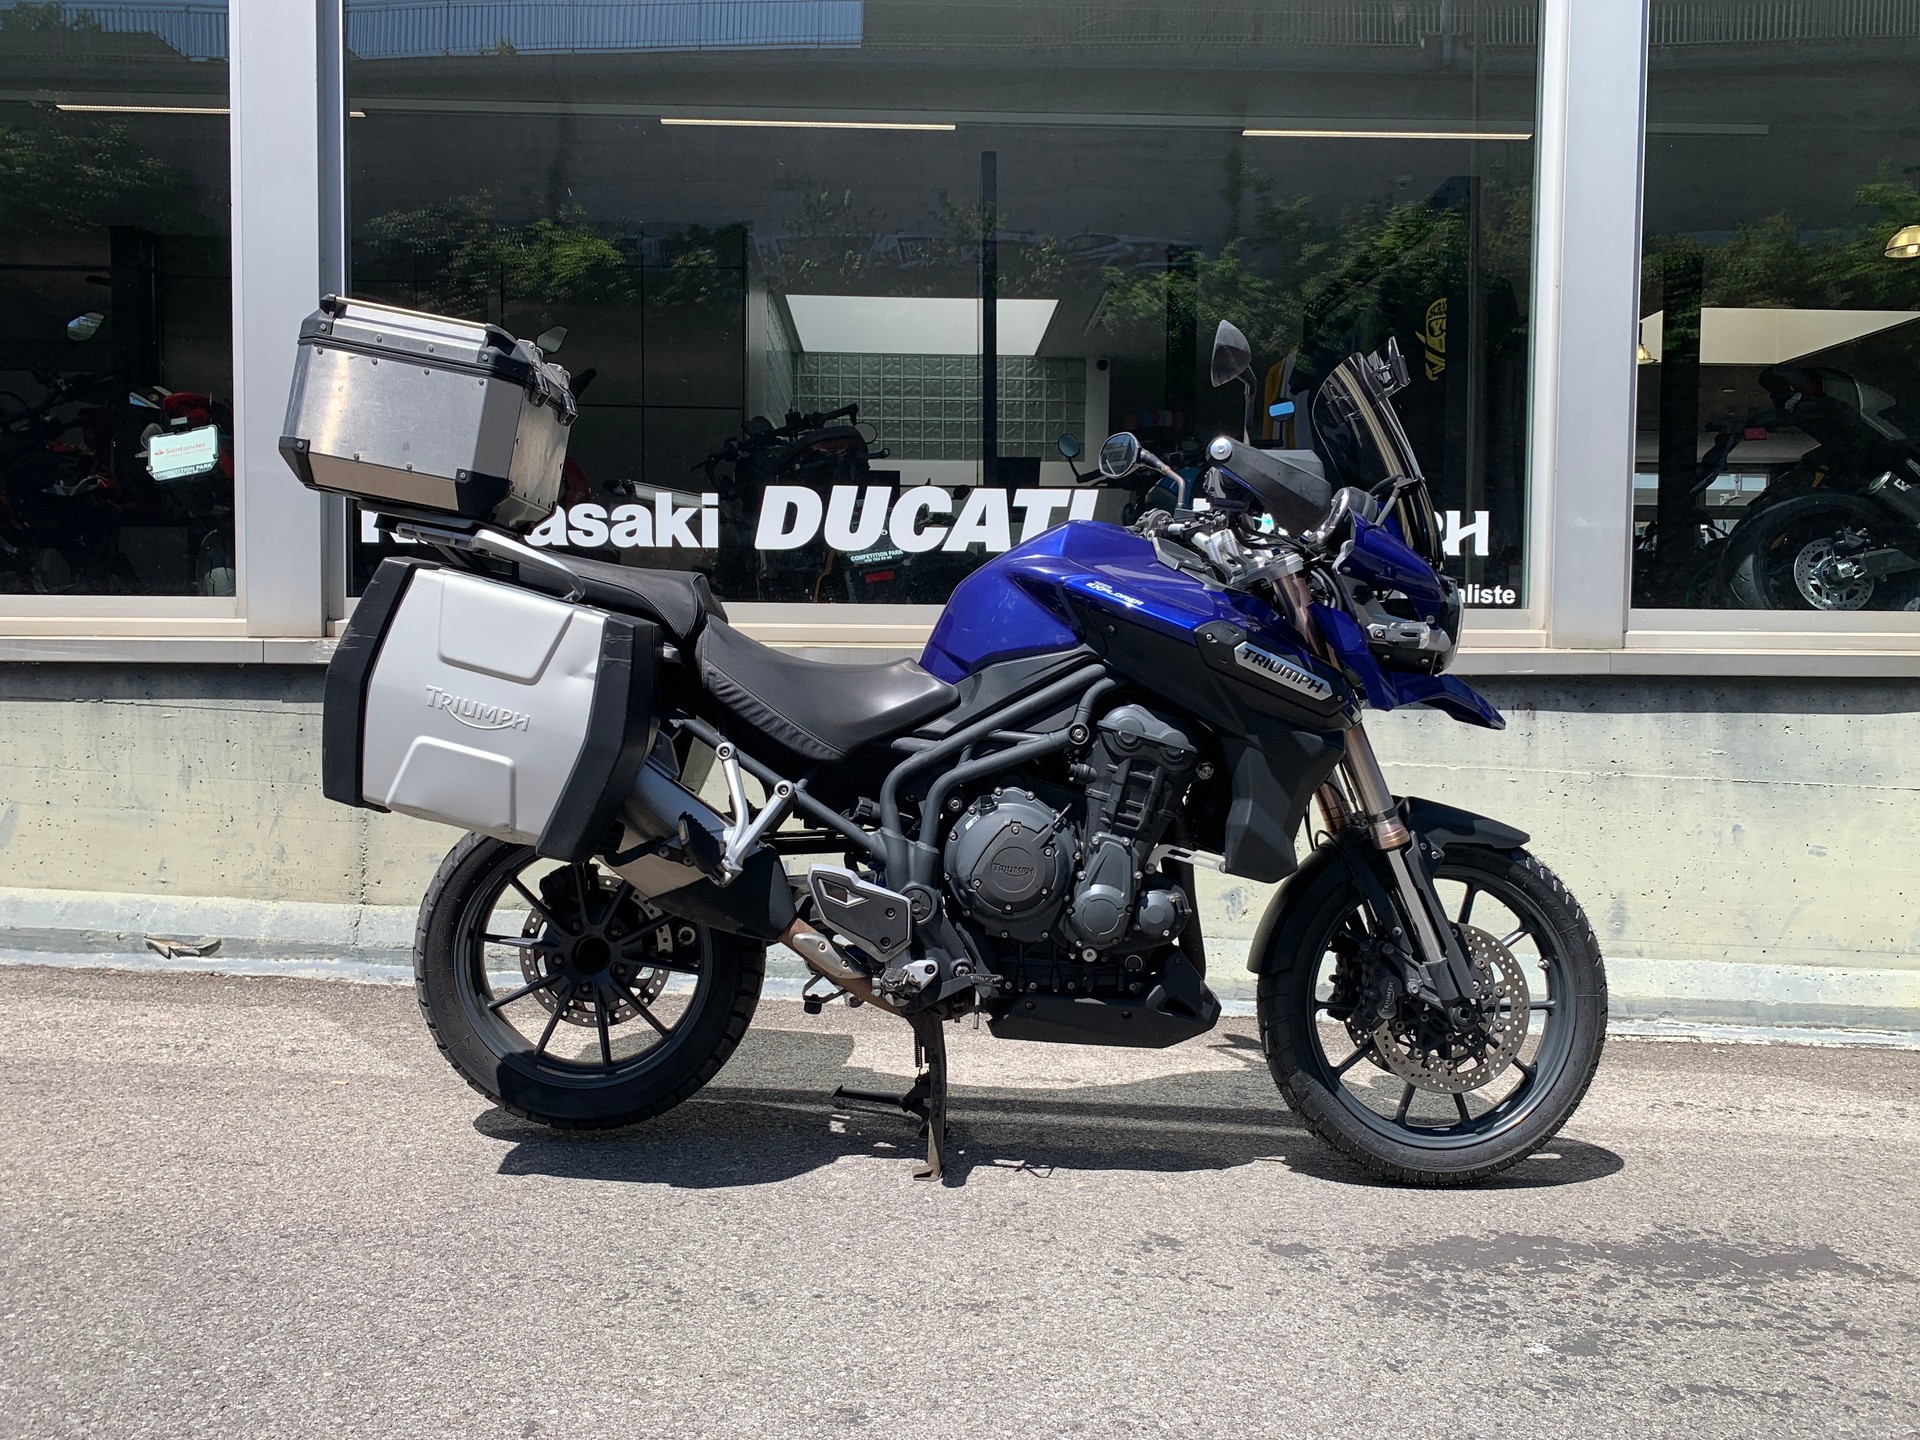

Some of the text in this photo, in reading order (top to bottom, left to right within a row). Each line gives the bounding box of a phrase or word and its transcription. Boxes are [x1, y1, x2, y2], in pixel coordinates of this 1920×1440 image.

[165, 443, 205, 454] Santander
[361, 492, 719, 548] asaki
[851, 552, 888, 561] COMPETITION
[1243, 647, 1325, 694] TRIUMPH
[425, 684, 531, 732] TRIUMPH
[993, 862, 1034, 877] TRIUMPH
[1381, 981, 1395, 1013] TRIUMPH
